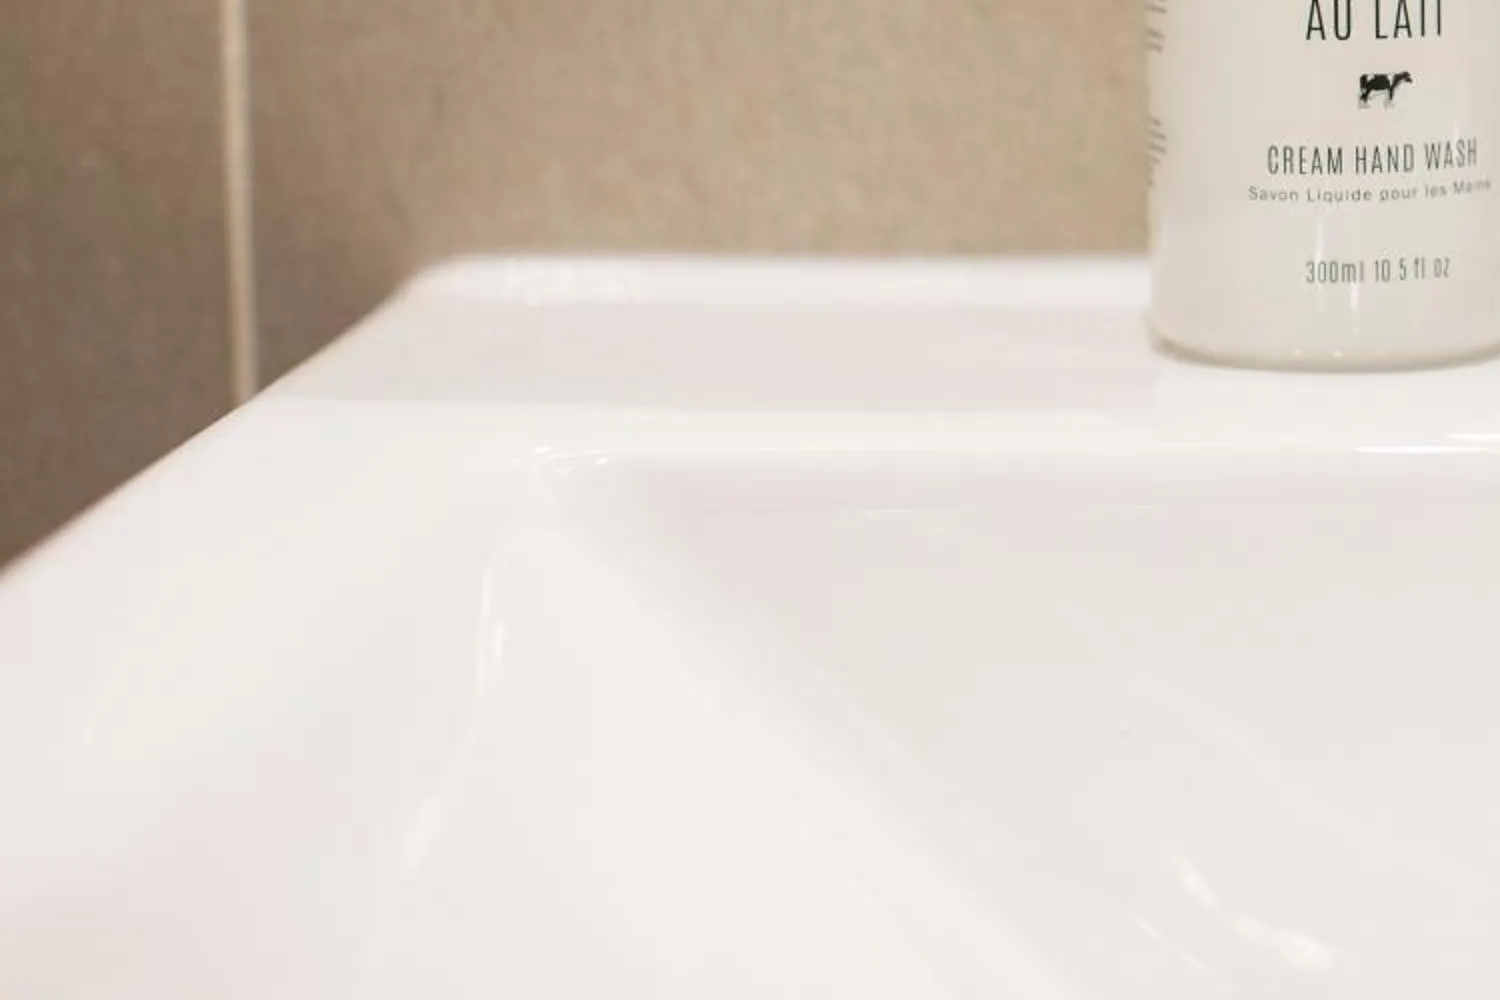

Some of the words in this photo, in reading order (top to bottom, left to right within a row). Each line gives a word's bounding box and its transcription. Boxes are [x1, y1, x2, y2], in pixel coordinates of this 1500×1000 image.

[1267, 145, 1343, 175] CREAM
[1355, 143, 1415, 174] HAND
[1424, 137, 1478, 171] WASH
[1248, 185, 1299, 201] Savon
[1306, 187, 1373, 205] Liquide
[1379, 188, 1418, 203] pour
[1425, 184, 1448, 198] les
[1305, 260, 1364, 284] 300ml
